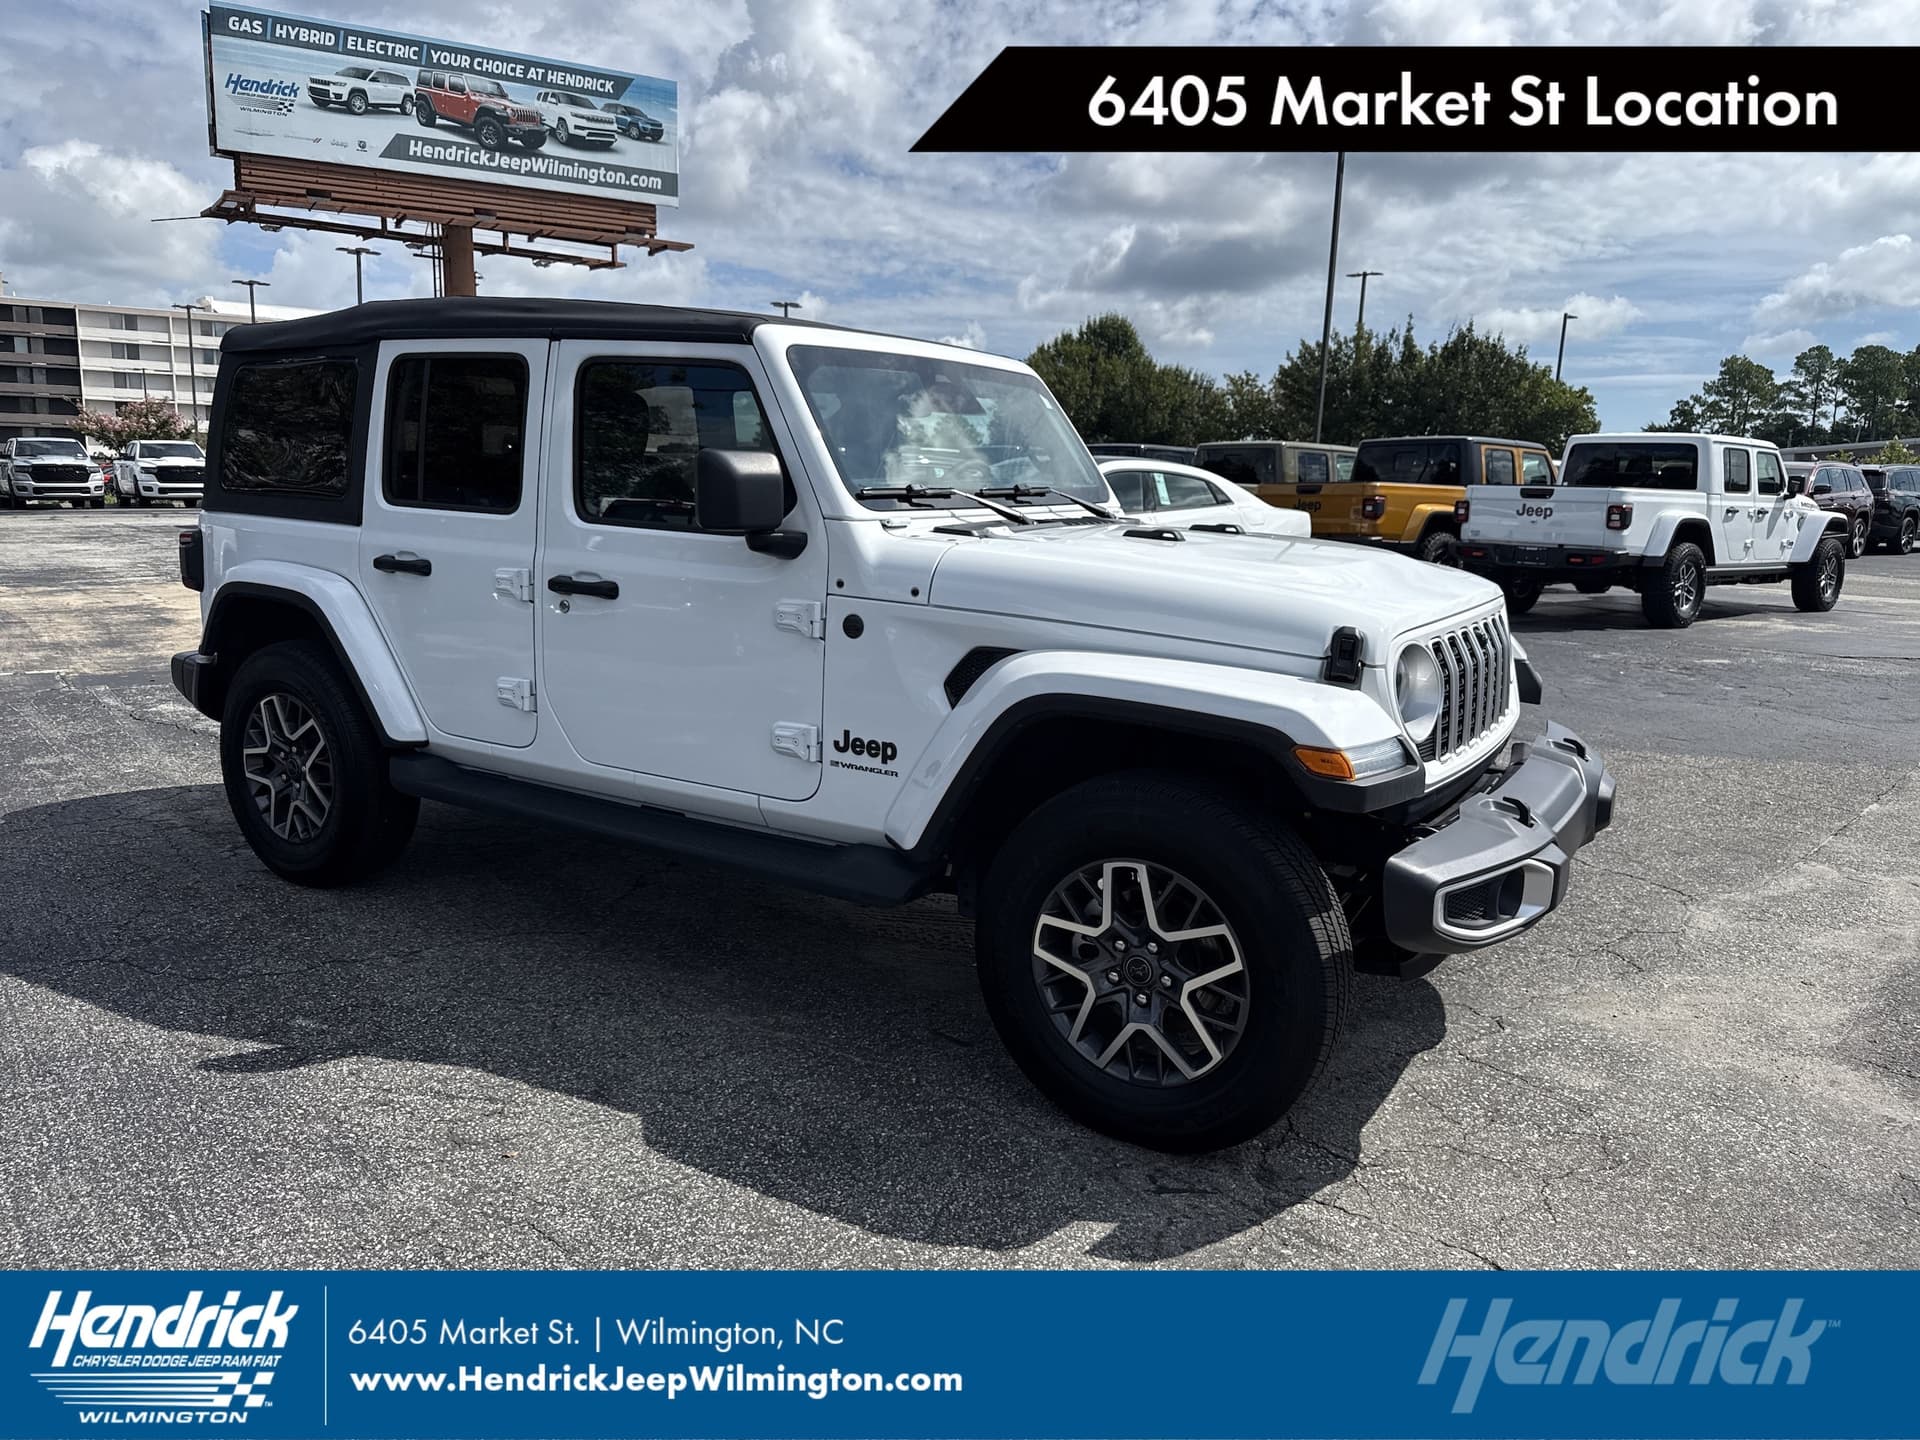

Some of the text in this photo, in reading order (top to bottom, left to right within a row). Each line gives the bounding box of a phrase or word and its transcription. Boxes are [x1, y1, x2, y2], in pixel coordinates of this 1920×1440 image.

[228, 16, 615, 94] GAS HYBRID ELECTRIC YOUR CHOICE AT HENDRICK
[225, 73, 300, 98] Hendrick
[239, 106, 288, 117] WILMINGTON
[408, 139, 663, 190] HendrickJeepWilmington.com
[1516, 503, 1553, 520] Jeep
[833, 729, 898, 765] Jeep
[839, 761, 899, 778] WRANGLER
